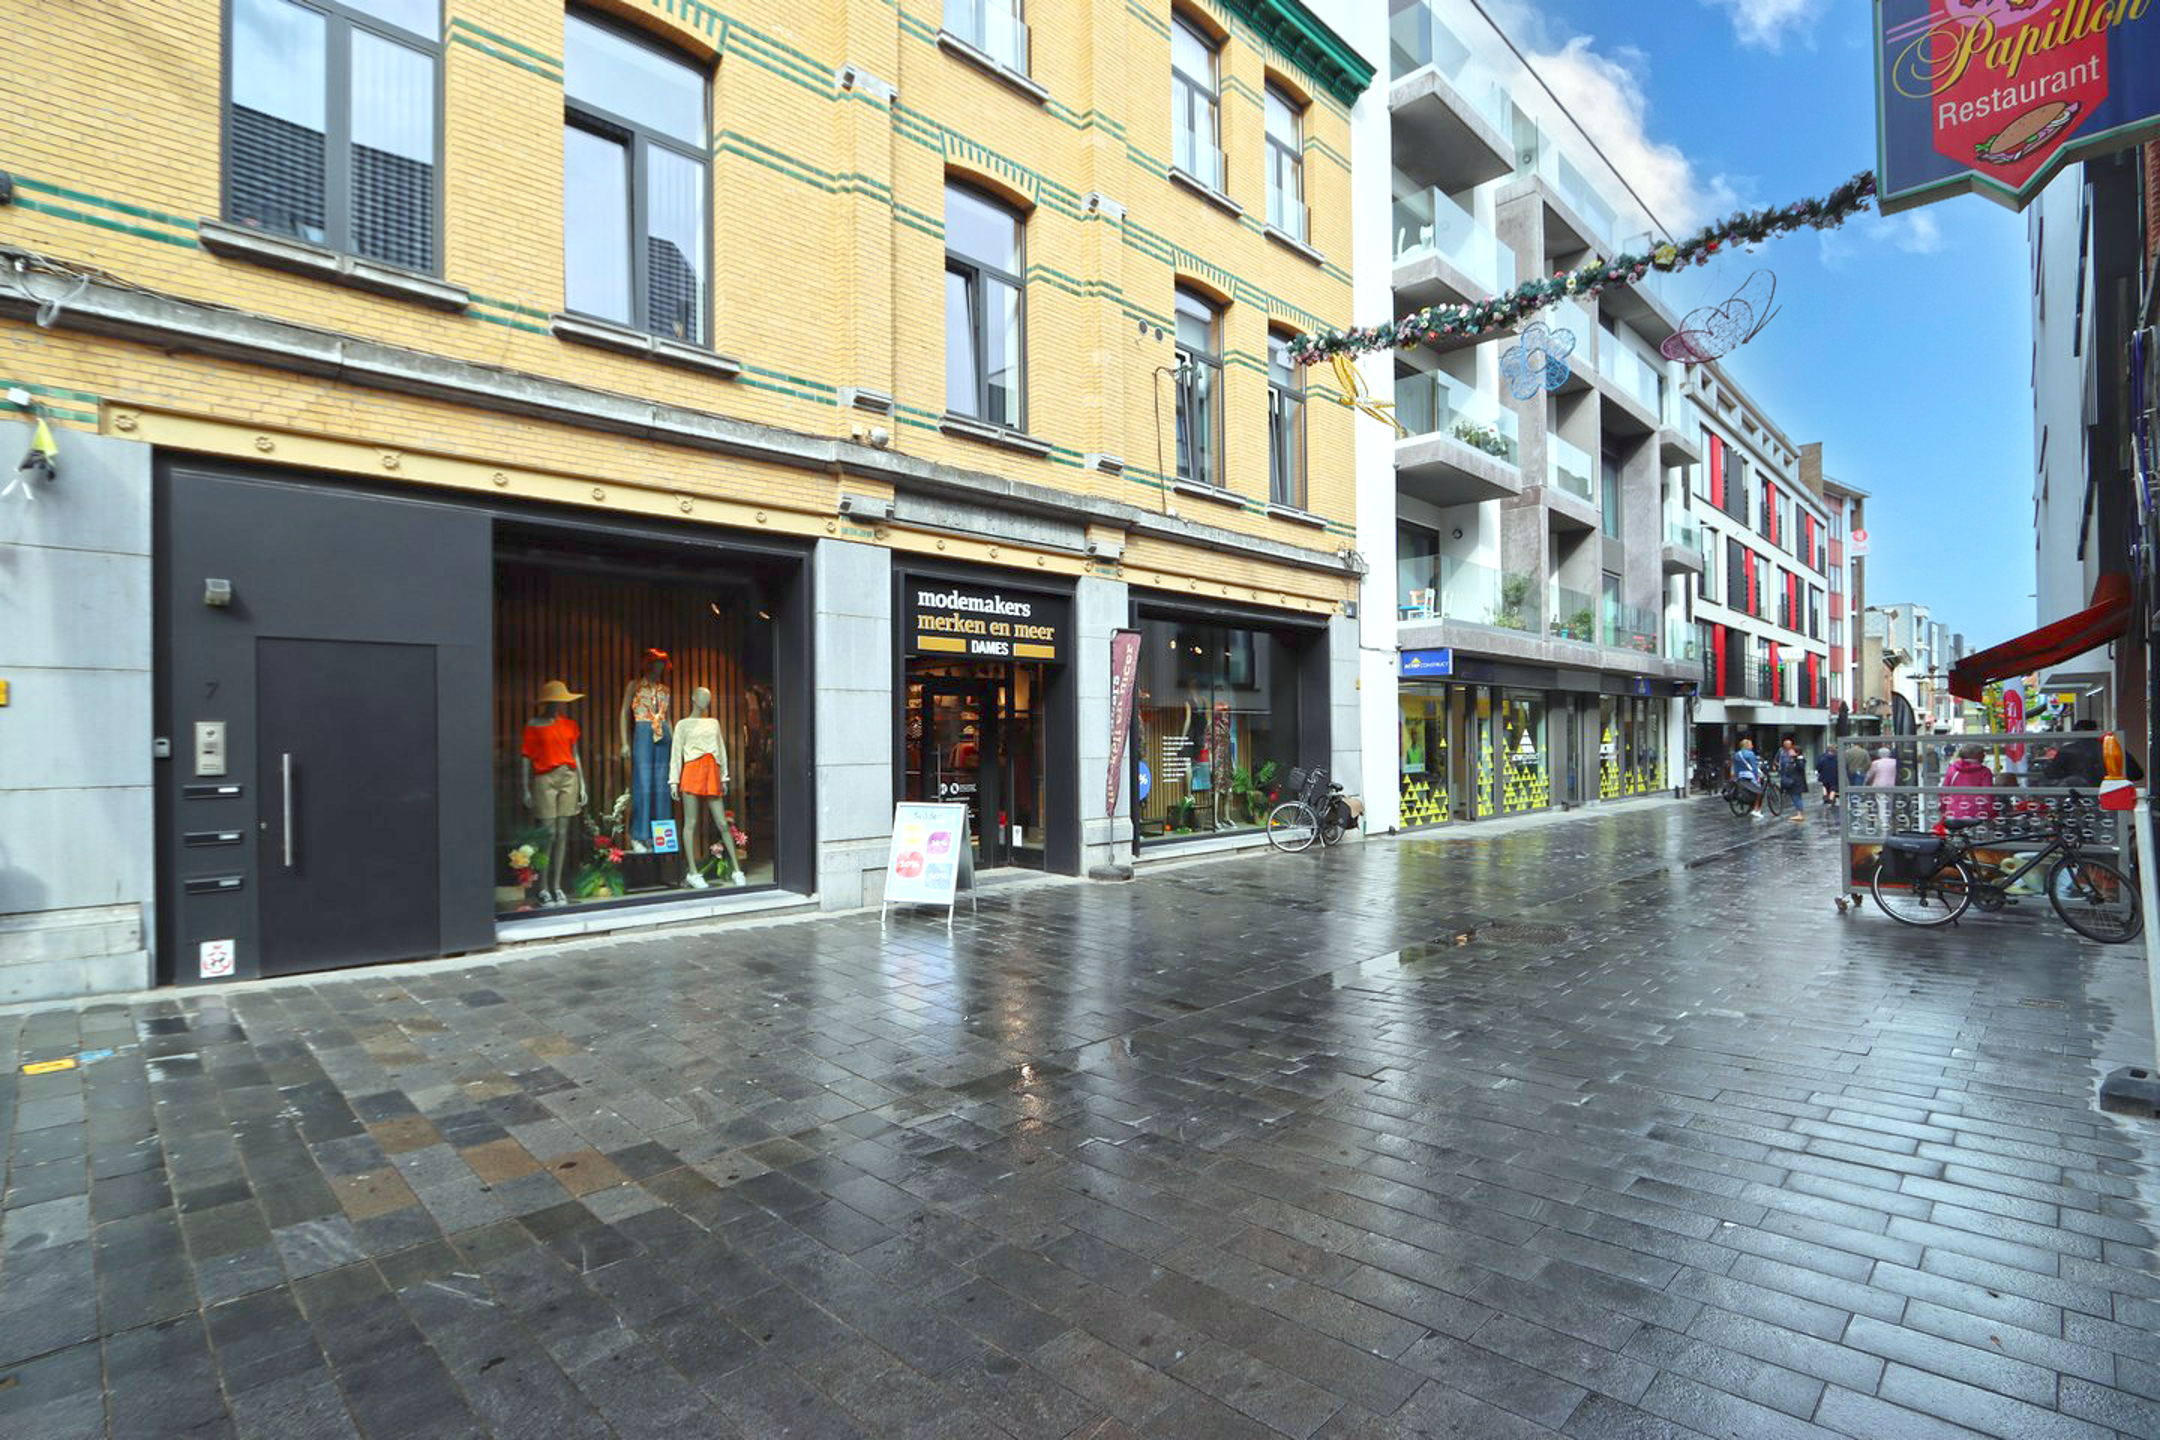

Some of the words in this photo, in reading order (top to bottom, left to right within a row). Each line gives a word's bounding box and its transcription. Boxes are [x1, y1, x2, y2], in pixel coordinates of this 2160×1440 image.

[1893, 0, 2151, 99] Papillon
[1939, 55, 2101, 130] Restaurant
[918, 591, 1031, 617] modemakers
[917, 613, 987, 636] merken
[989, 621, 1011, 637] en
[1014, 625, 1055, 640] meer
[971, 639, 1009, 656] DAMES
[205, 682, 219, 700] 7
